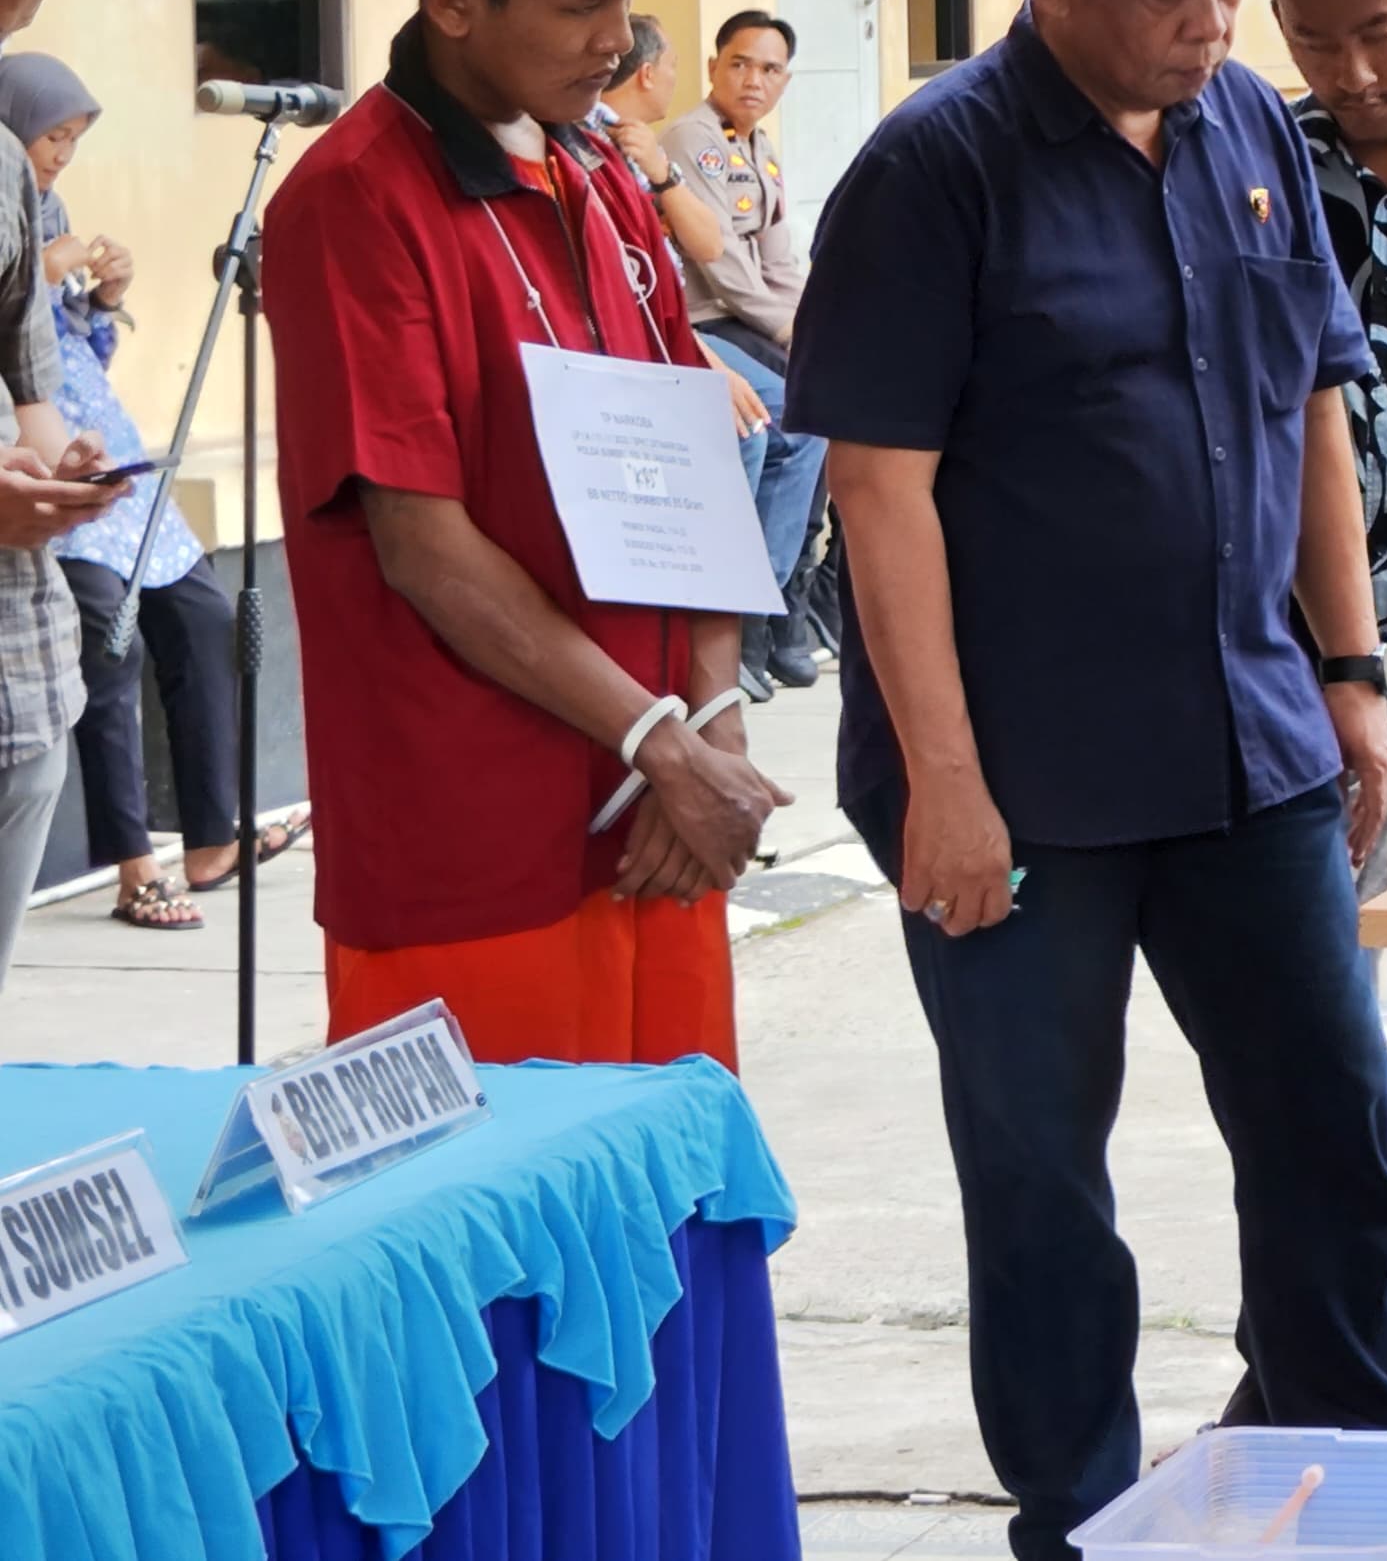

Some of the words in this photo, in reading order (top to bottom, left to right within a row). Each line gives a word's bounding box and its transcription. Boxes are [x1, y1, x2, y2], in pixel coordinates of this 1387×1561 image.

[281, 1071, 361, 1160] BID
[333, 1032, 471, 1140] PROPAM
[0, 1167, 156, 1300] SUMSEL
